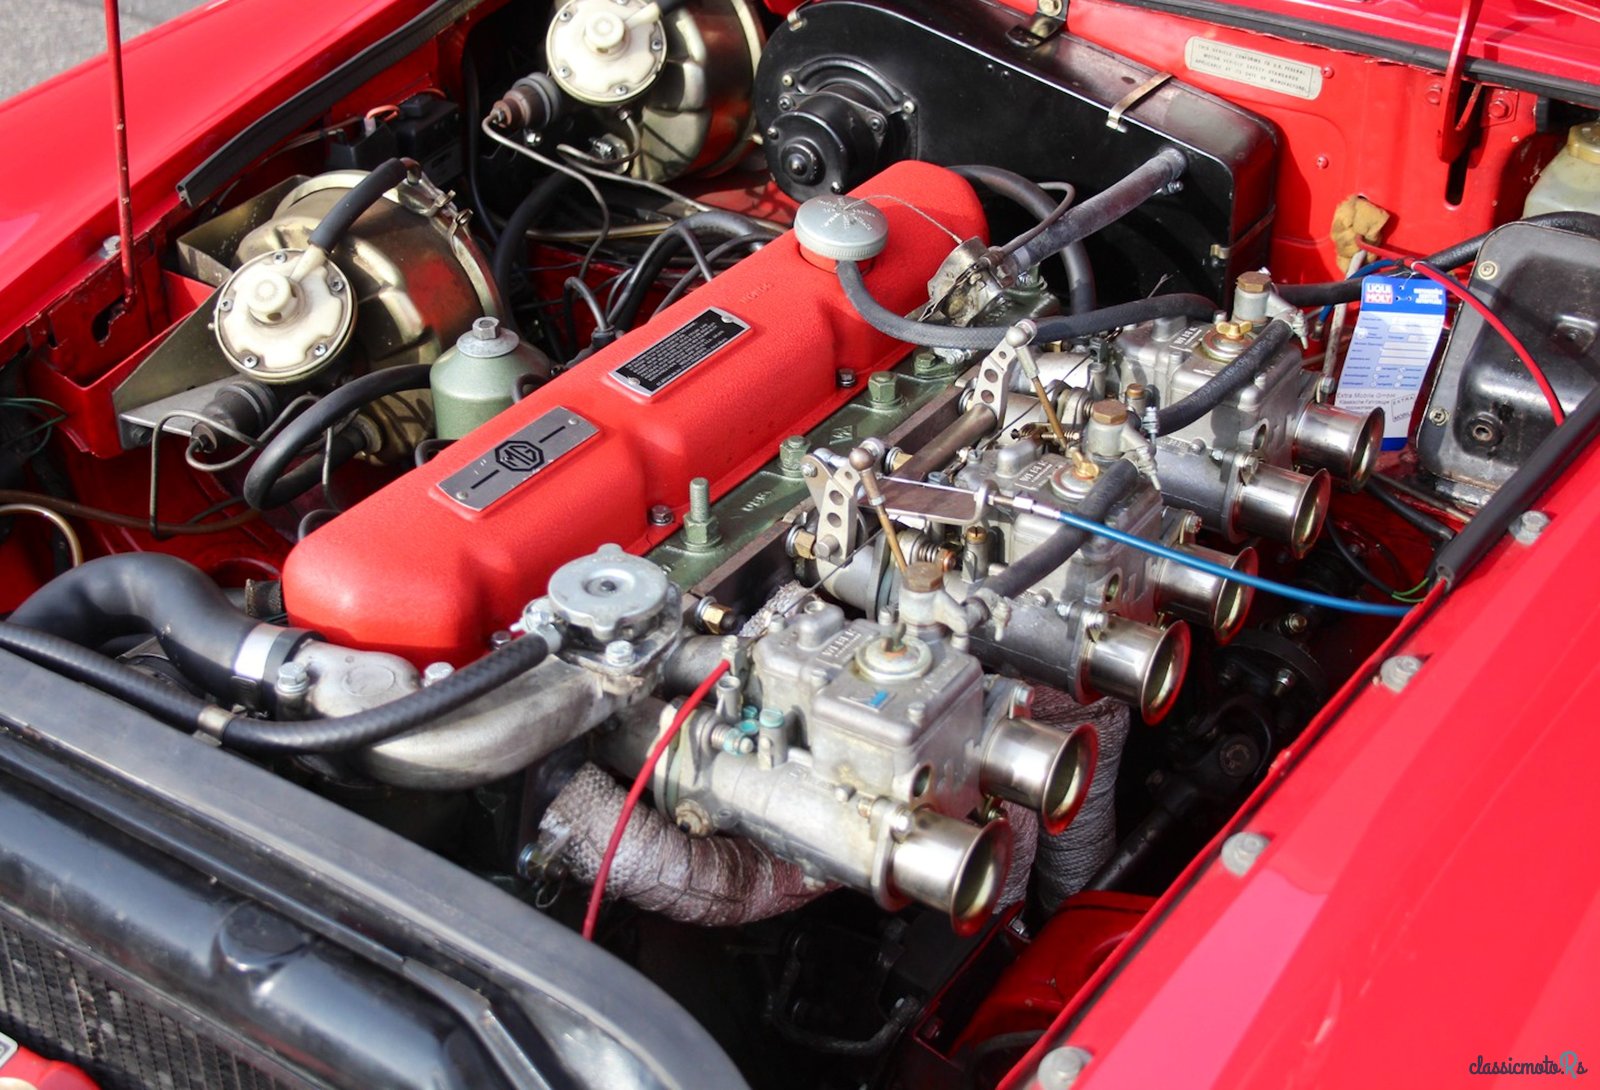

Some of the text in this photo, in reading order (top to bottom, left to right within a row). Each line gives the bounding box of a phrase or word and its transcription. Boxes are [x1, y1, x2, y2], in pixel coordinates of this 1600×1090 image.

[1366, 283, 1392, 293] LIQUI
[1366, 293, 1392, 304] MOLY
[499, 443, 538, 468] MG
